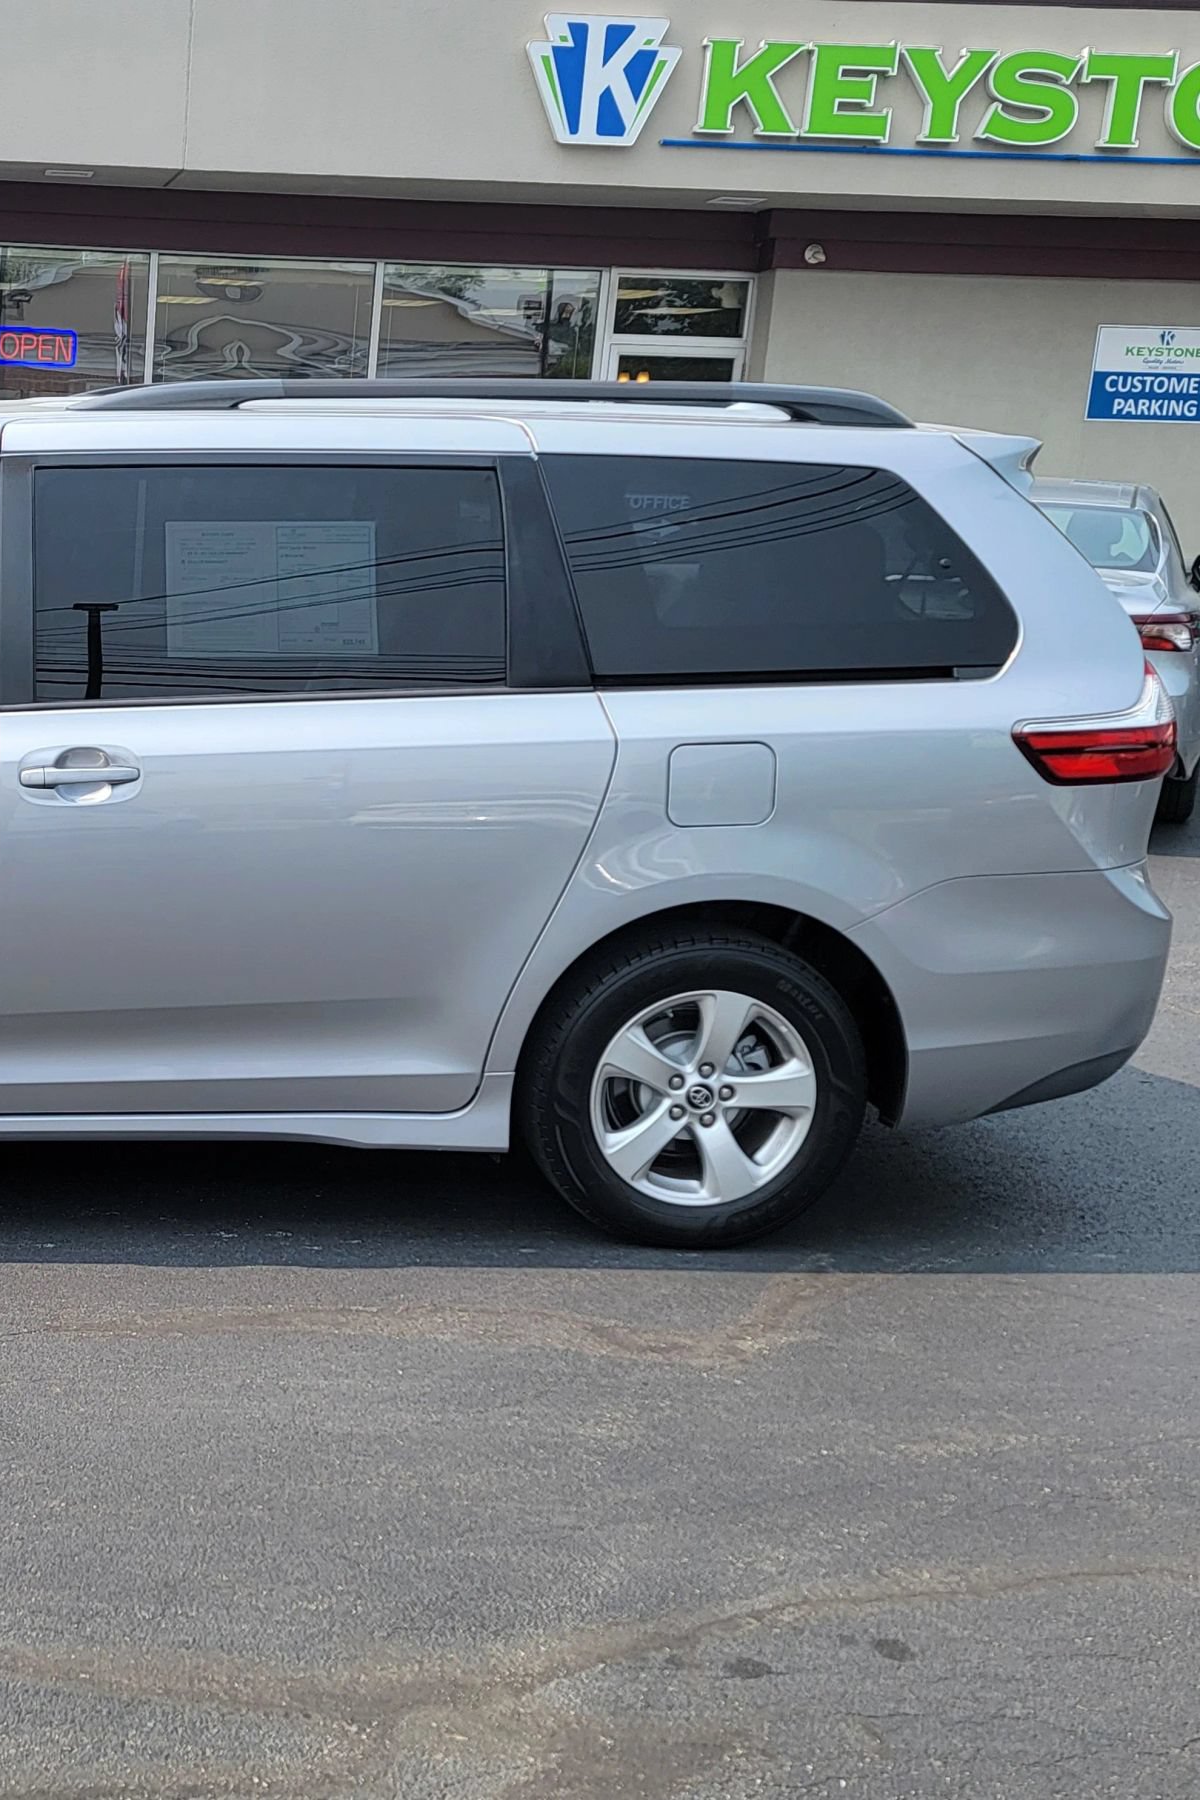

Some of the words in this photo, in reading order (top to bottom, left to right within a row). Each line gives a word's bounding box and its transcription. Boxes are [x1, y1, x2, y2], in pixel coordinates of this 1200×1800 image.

[0, 332, 73, 362] OPEN
[1112, 398, 1198, 417] PARKING
[629, 495, 691, 510] OFFICE
